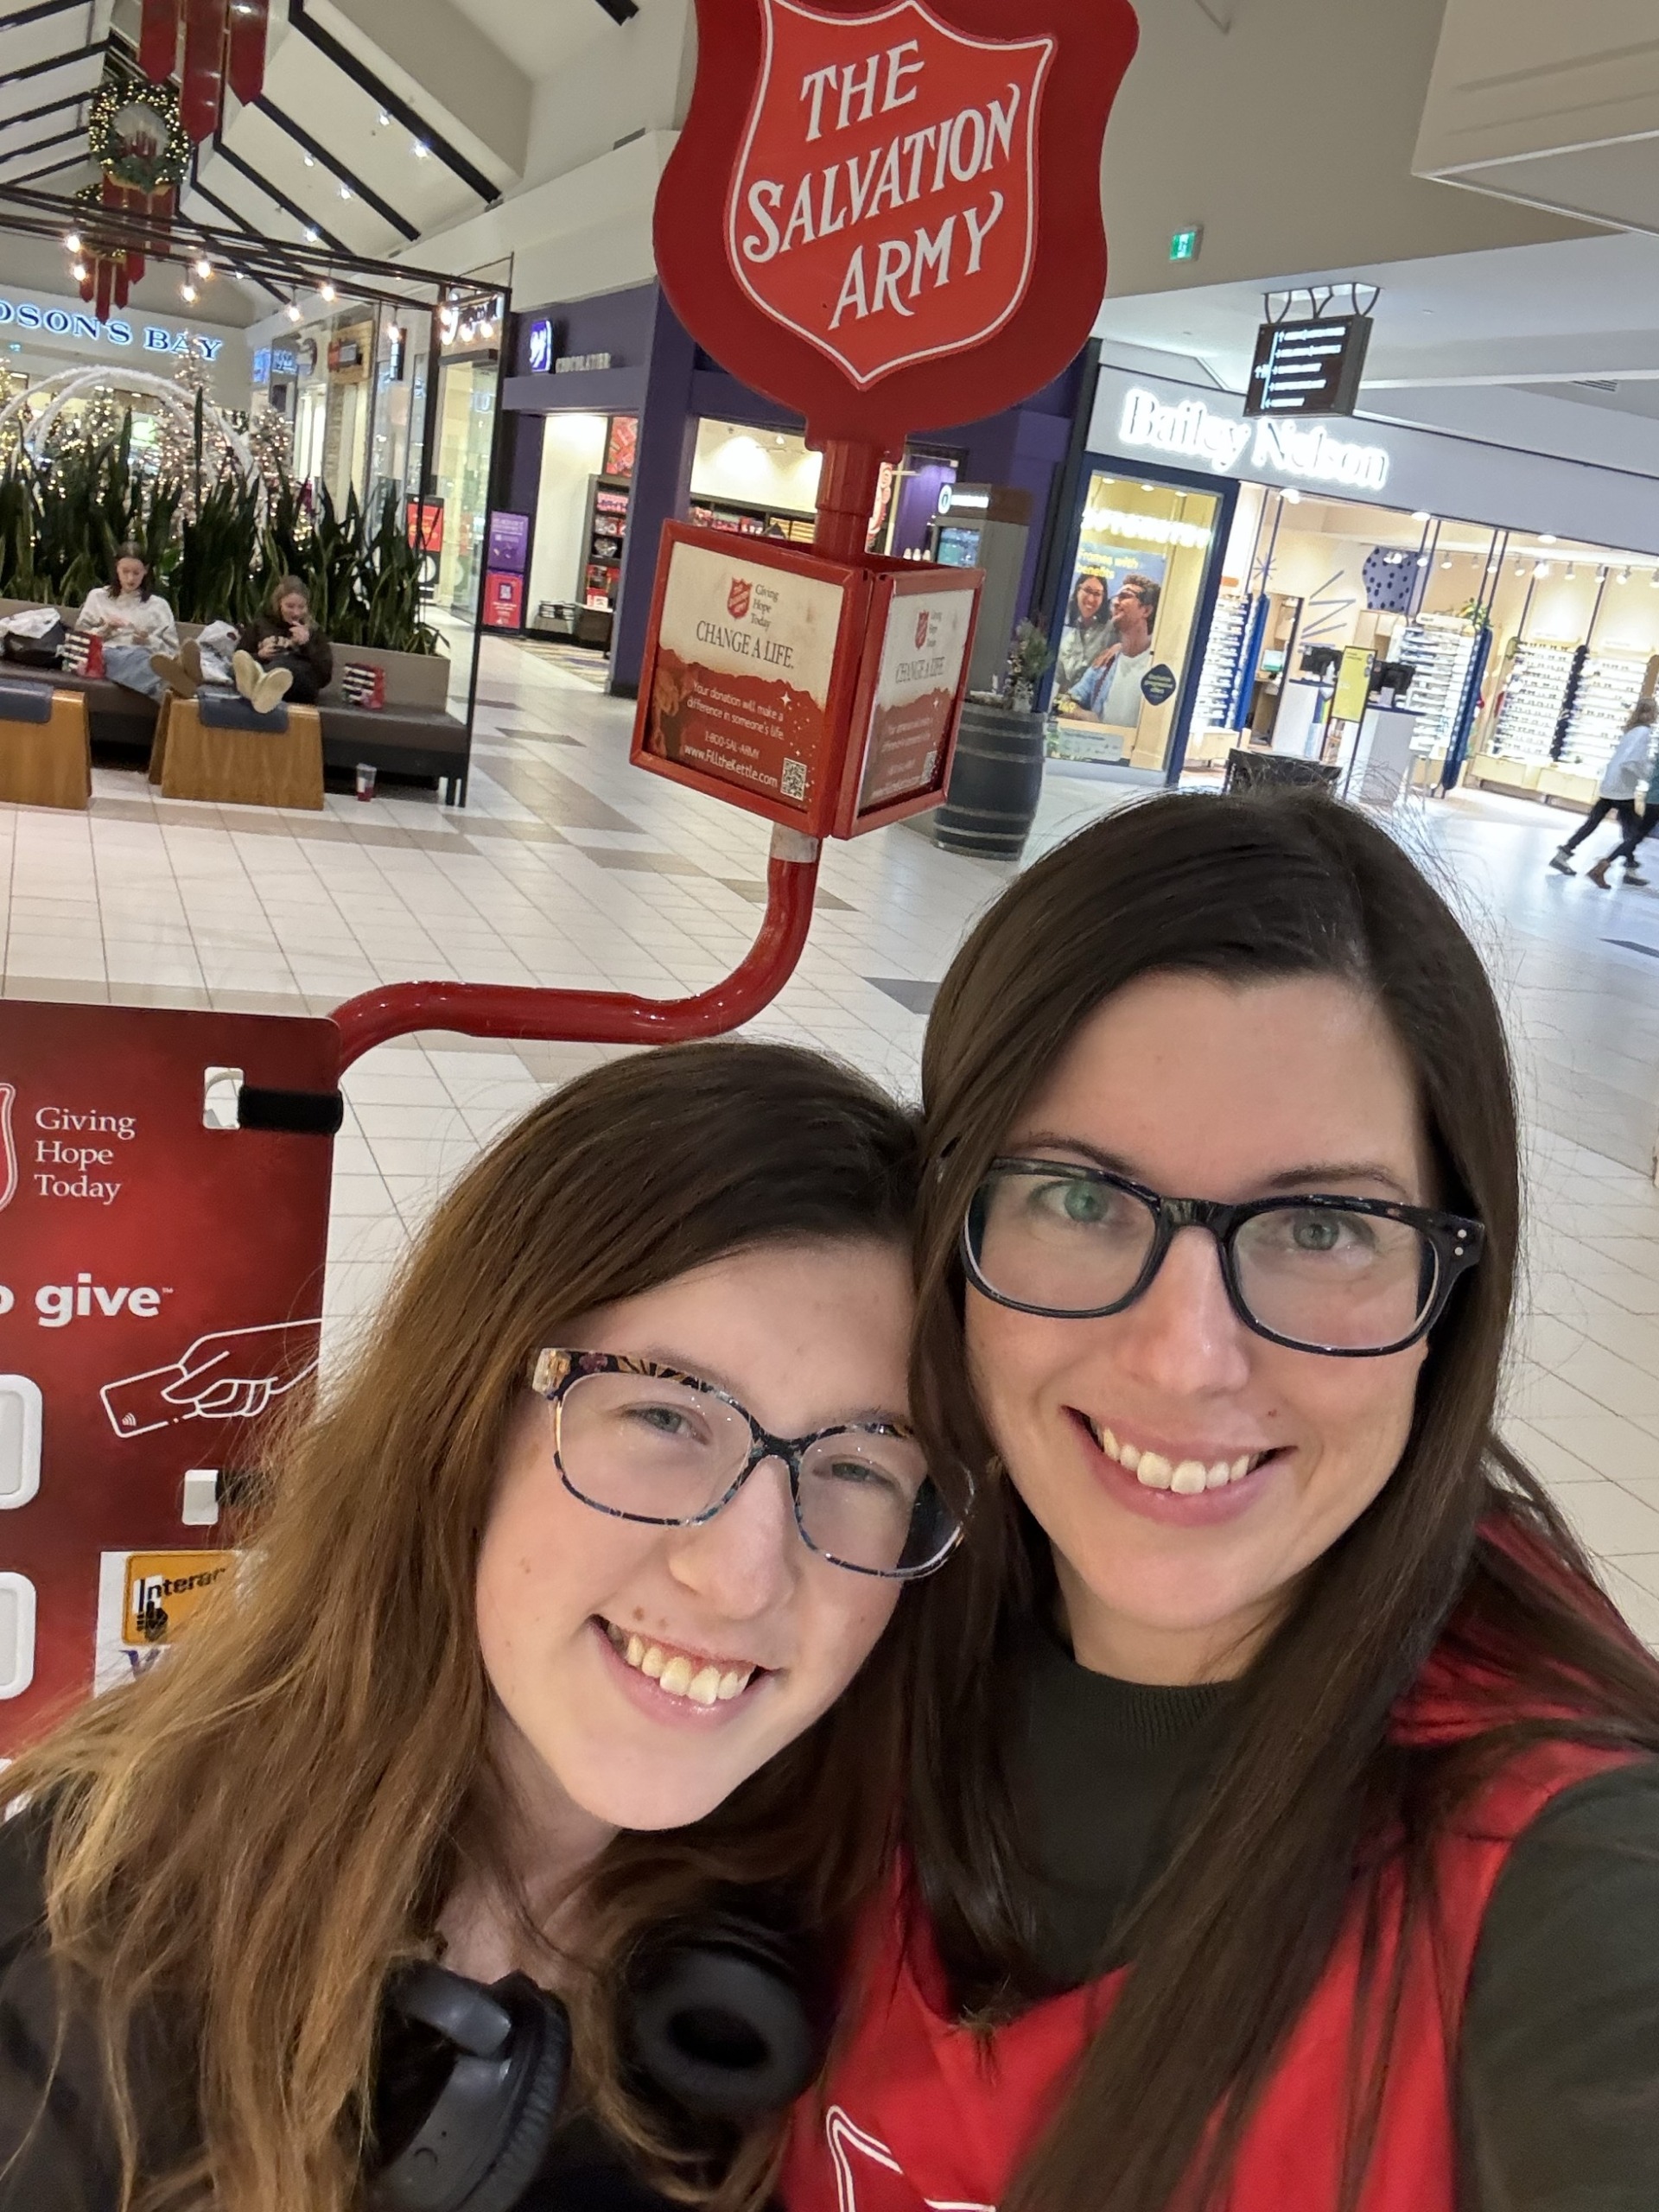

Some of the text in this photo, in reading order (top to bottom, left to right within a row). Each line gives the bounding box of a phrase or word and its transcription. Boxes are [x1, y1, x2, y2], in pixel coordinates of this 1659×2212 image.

[800, 39, 925, 142] THE
[742, 83, 1020, 263] SALVATION
[828, 191, 1003, 330] ARMY
[143, 326, 223, 360] BAY
[1120, 388, 1389, 490] Bailey Nelson
[753, 598, 772, 615] Hope
[754, 582, 779, 603] Giving
[750, 613, 772, 632] Today
[696, 620, 795, 670] CHANGE A LIFE.
[686, 696, 723, 719] difference
[731, 714, 769, 736] someone's
[693, 680, 709, 696] Your
[709, 687, 741, 708] donation
[742, 698, 756, 712] will
[757, 704, 778, 720] make
[35, 1106, 136, 1141] Giving
[35, 1140, 114, 1172] Hope
[34, 1173, 121, 1205] Today
